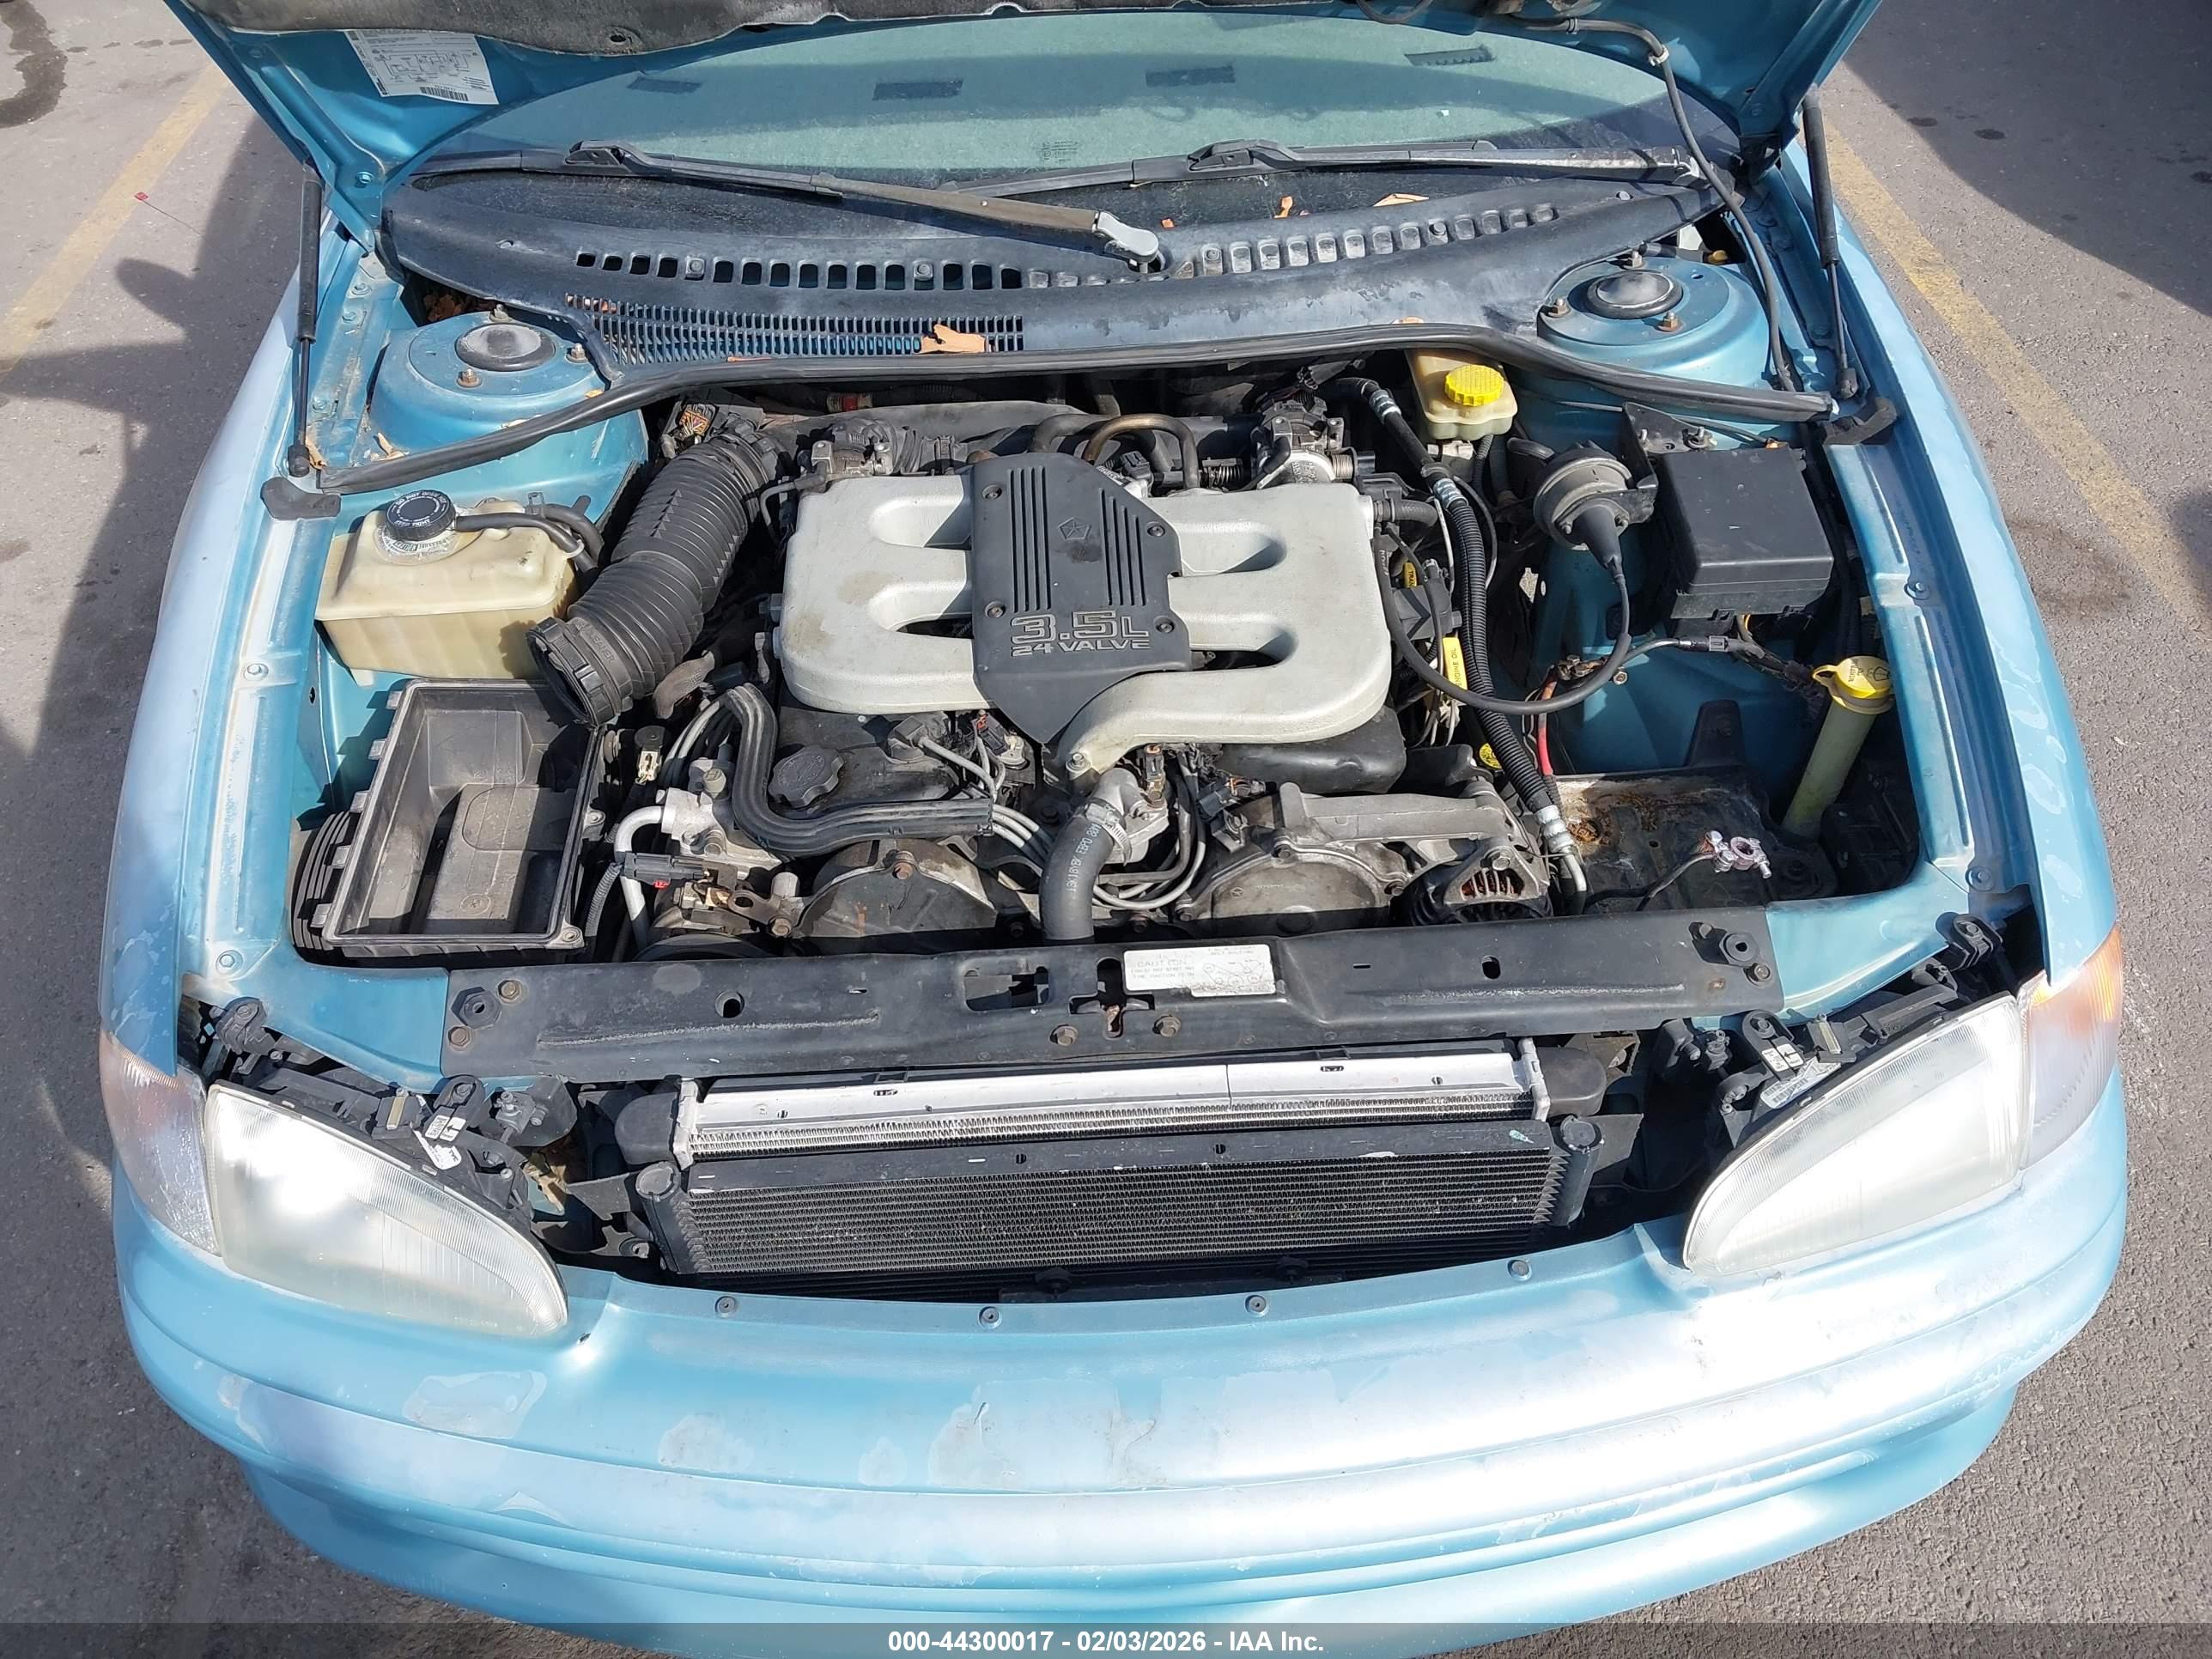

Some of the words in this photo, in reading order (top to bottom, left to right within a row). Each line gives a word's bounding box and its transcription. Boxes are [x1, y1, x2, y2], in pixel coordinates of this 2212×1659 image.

[1011, 610, 1150, 644] 3.5L
[1011, 642, 1054, 658] 24
[1058, 639, 1152, 652] VALVE
[1136, 959, 1188, 968] CAUTION
